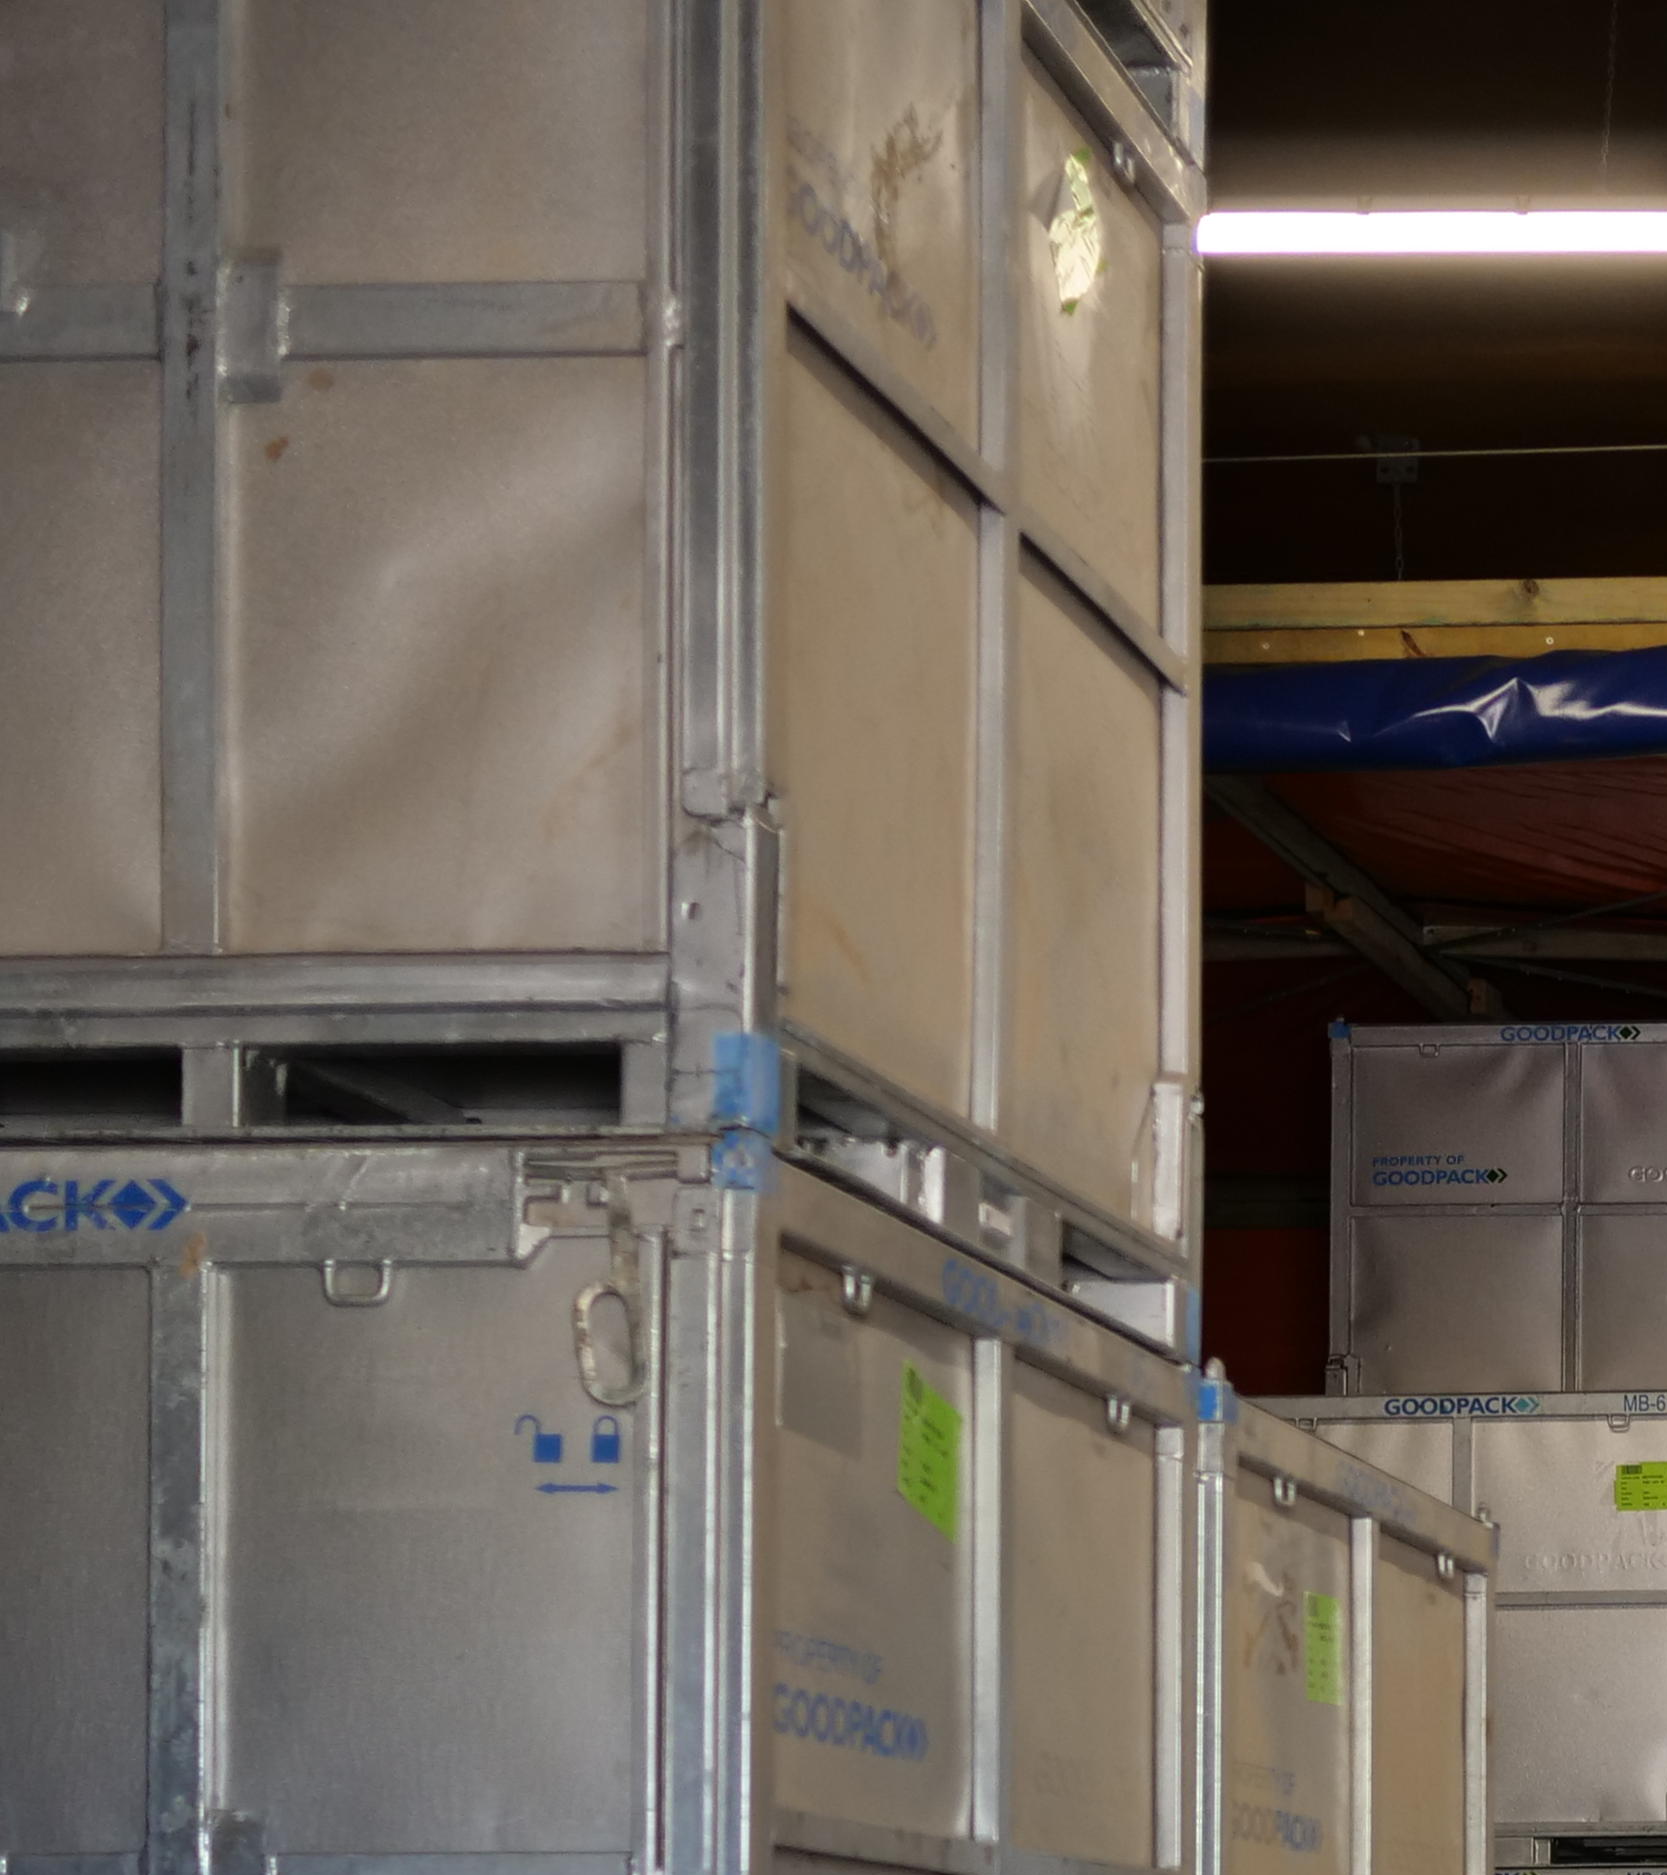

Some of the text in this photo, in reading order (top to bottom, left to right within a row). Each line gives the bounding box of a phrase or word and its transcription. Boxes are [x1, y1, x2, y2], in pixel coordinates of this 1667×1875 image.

[1500, 1025, 1621, 1042] GOODPACK
[1372, 1155, 1465, 1167] PROPERTY OF
[1372, 1169, 1488, 1186] GOODPACK
[1384, 1394, 1666, 1415] GOODPACK MB-6
